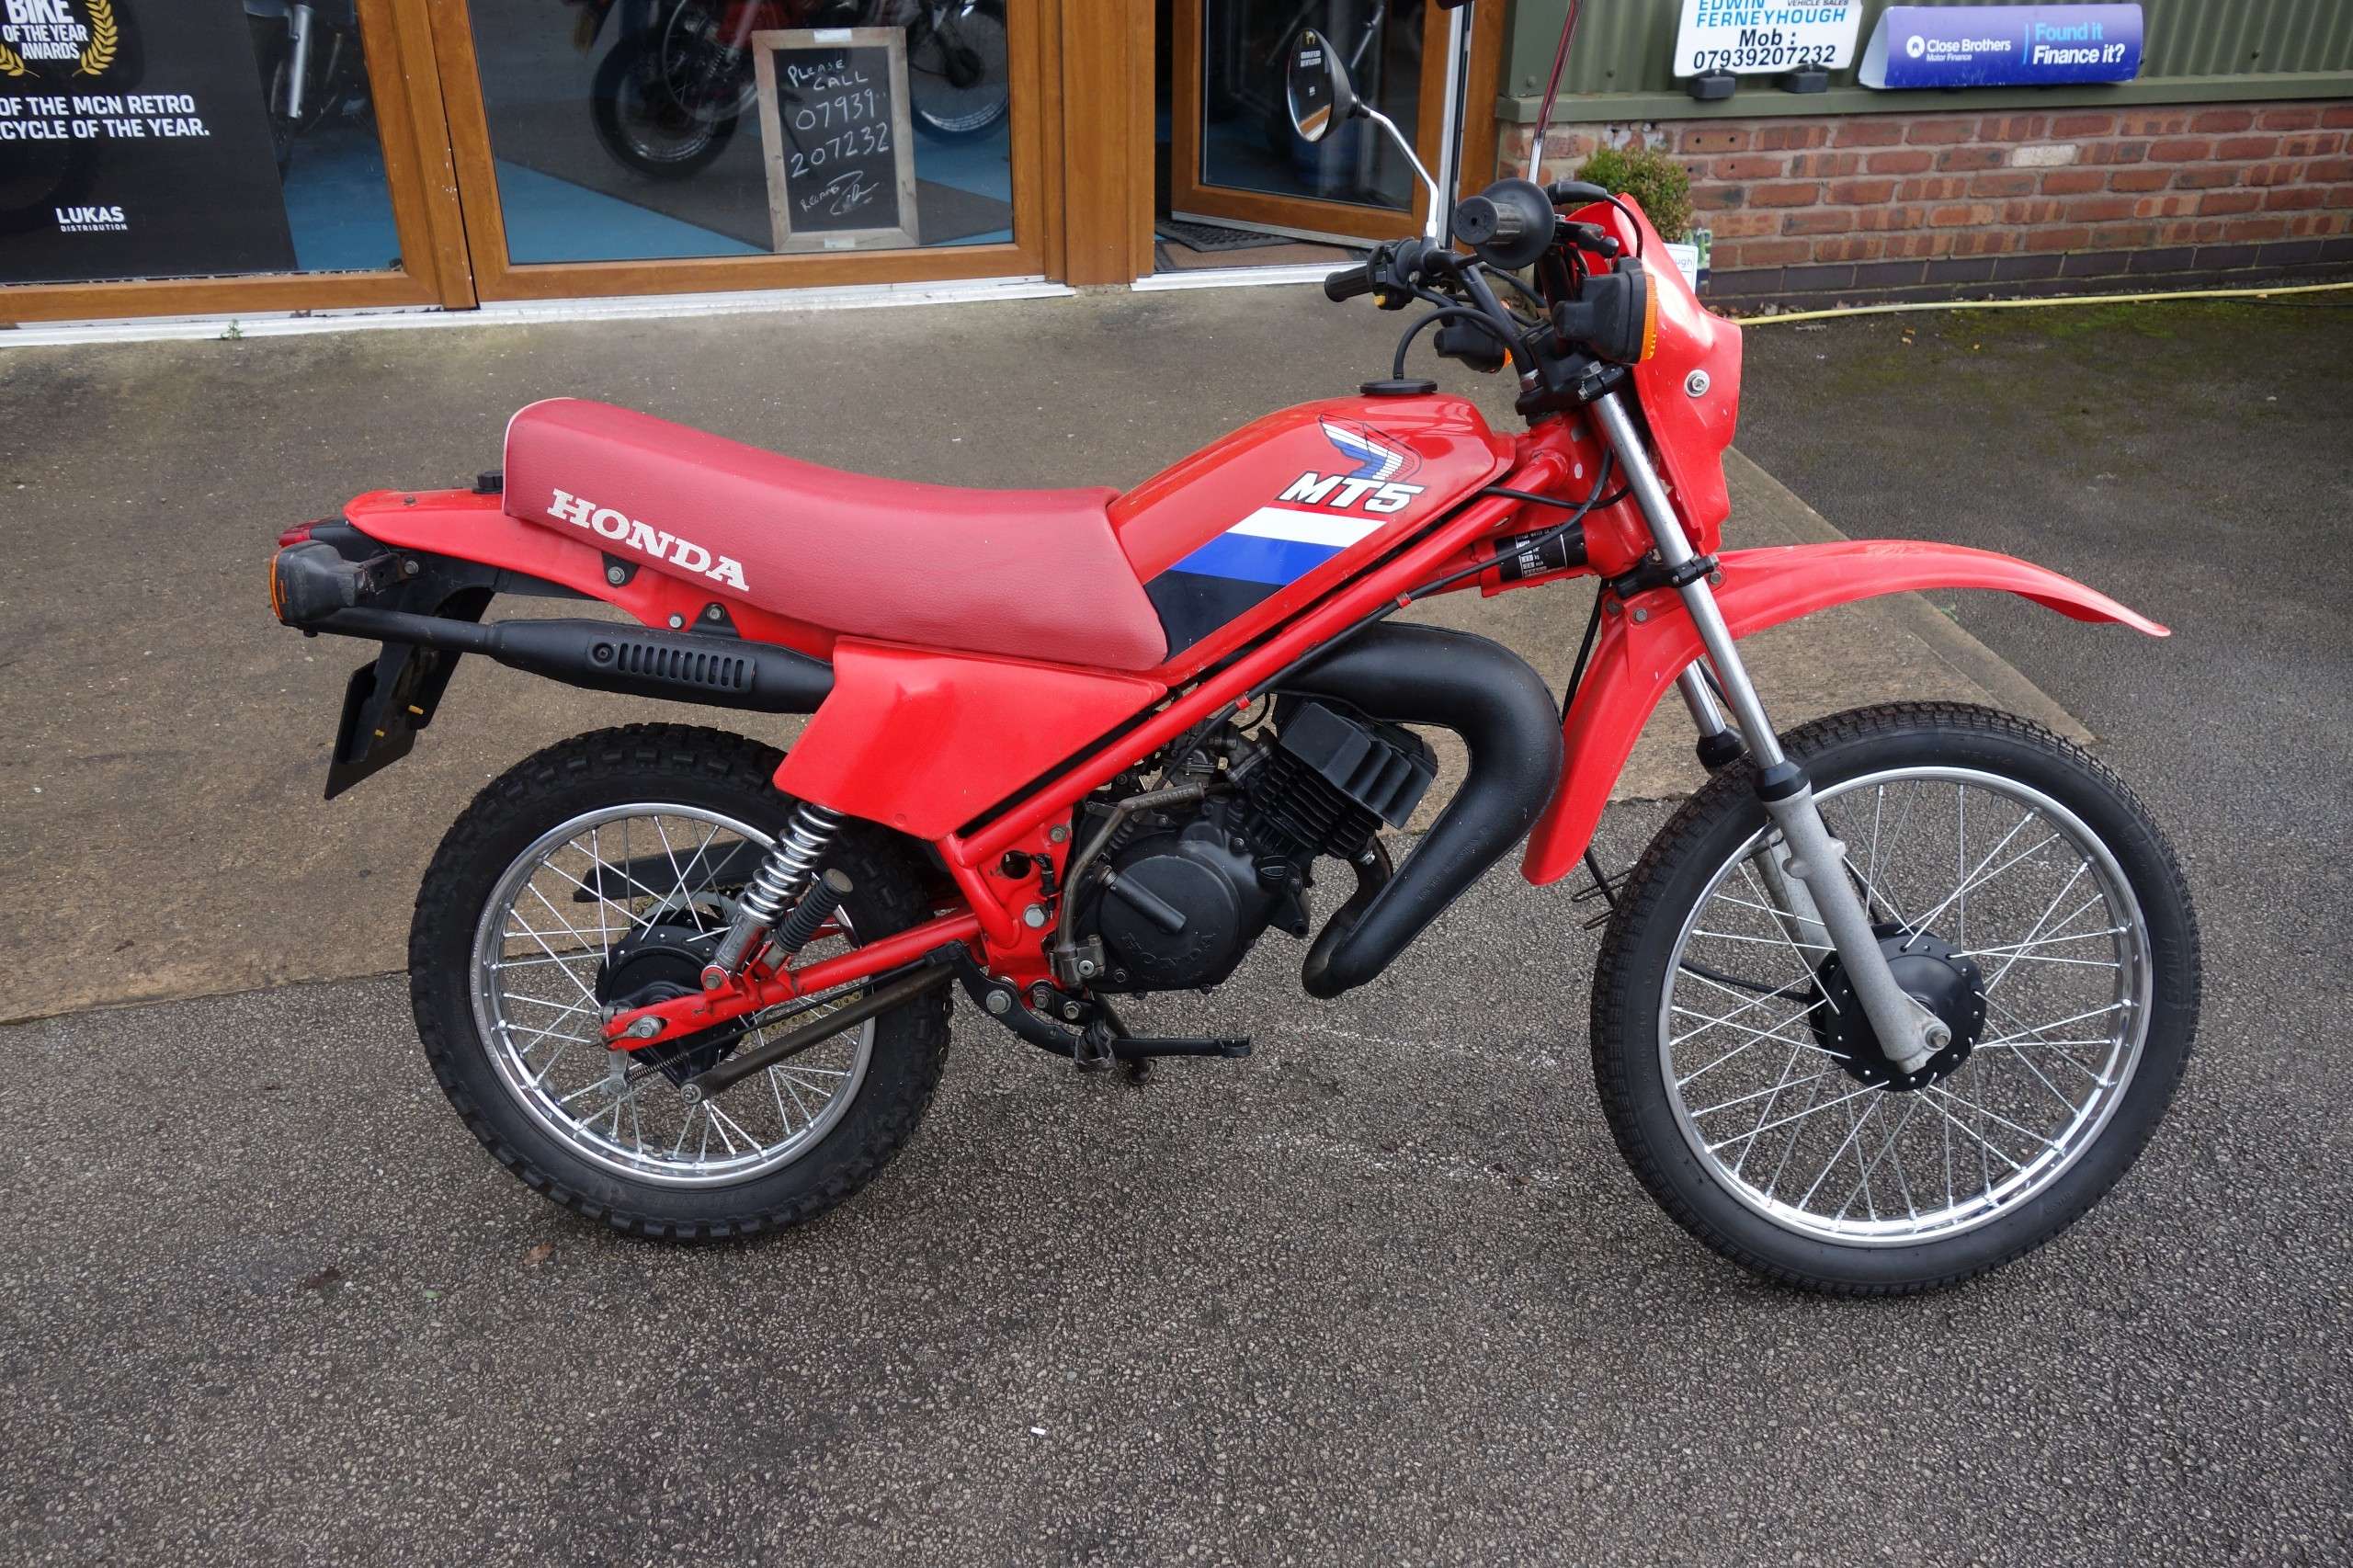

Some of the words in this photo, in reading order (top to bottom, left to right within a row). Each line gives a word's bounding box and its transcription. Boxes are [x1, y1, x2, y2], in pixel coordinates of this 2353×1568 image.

[6, 0, 74, 24] BIKE
[1699, 0, 1766, 10] EDWIN
[1697, 8, 1847, 28] FERNEYHOUGH
[2, 25, 21, 42] OF
[22, 25, 51, 42] THE
[49, 24, 89, 42] YEAR
[1739, 28, 1782, 47] Mob
[2034, 22, 2088, 41] Found
[2092, 22, 2103, 40] it
[21, 42, 81, 60] AWARDS
[1927, 39, 1960, 52] Close
[1961, 38, 2011, 51] Brothers
[2032, 44, 2100, 64] Finance
[2102, 42, 2126, 63] it?
[1693, 45, 1836, 69] 07939207232
[1926, 52, 1946, 62] Motor
[1947, 52, 1972, 62] Finance
[788, 59, 846, 88] PLEASE
[813, 72, 869, 91] CALL
[0, 97, 23, 117] OF
[26, 97, 70, 116] THE
[72, 96, 123, 115] MCN
[127, 95, 196, 114] RETRO
[0, 120, 68, 140] CYCLE
[72, 119, 100, 139] OF
[103, 119, 145, 138] THE
[147, 118, 210, 137] YEAR.
[790, 122, 890, 178] 207232
[55, 206, 125, 224] LUKAS
[60, 222, 129, 233] DISTRIBUTION
[1275, 471, 1427, 514] MT5
[546, 488, 750, 592] HONDA
